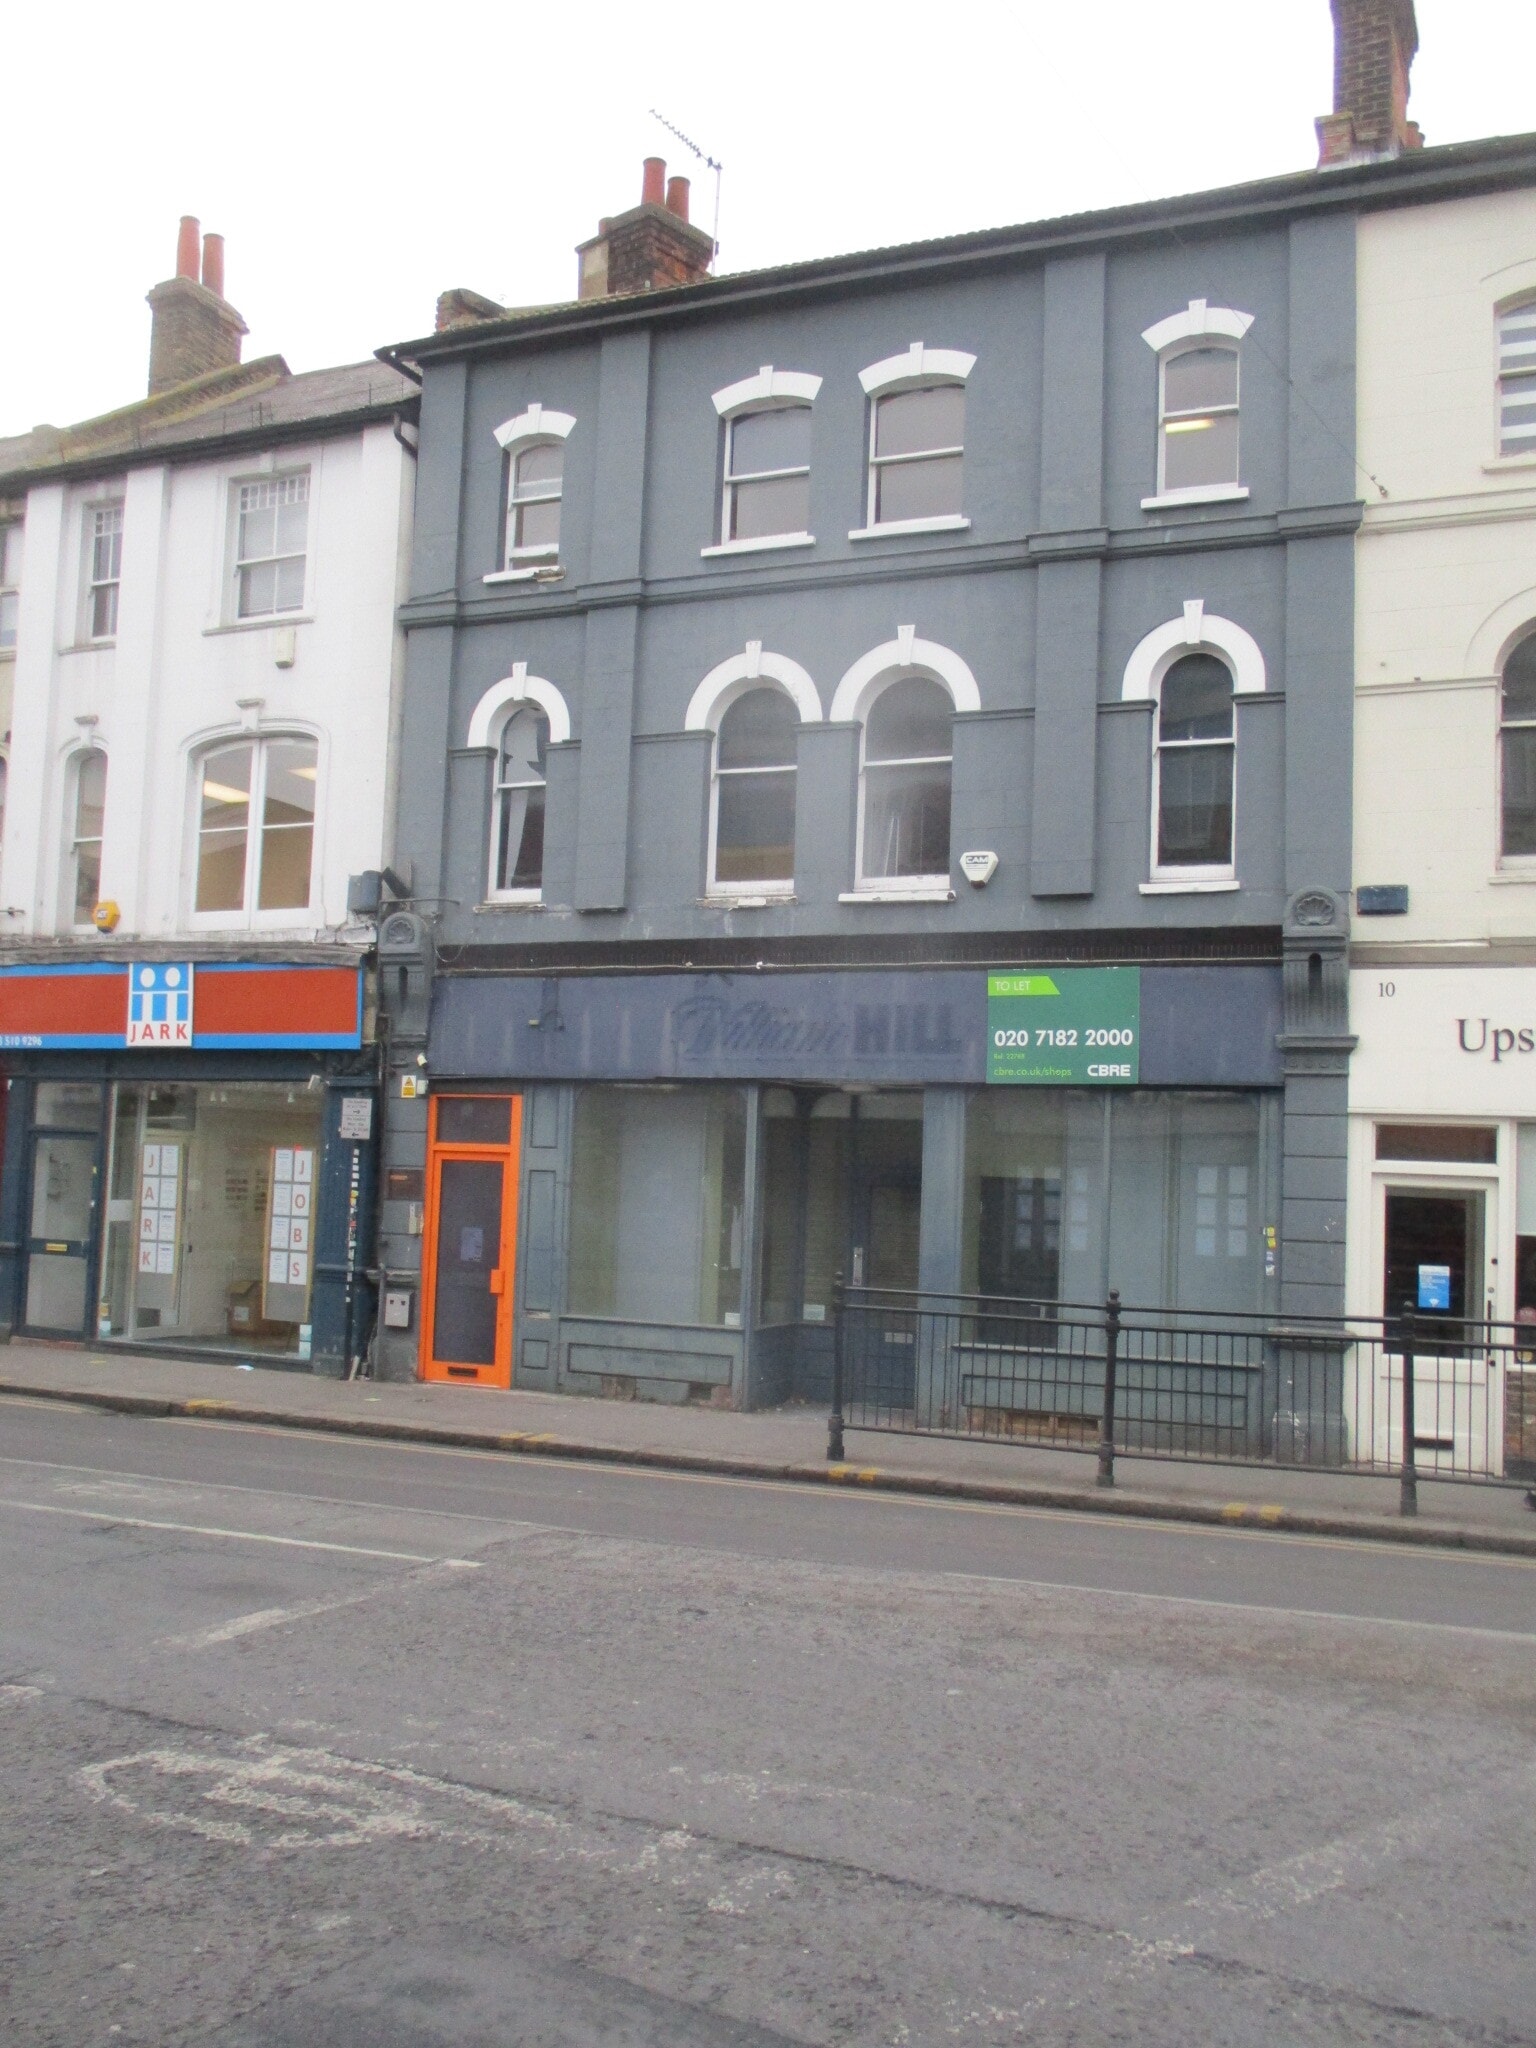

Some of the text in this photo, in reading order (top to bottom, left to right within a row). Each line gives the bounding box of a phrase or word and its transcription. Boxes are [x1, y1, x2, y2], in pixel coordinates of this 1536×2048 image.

[966, 856, 988, 864] CAM
[995, 980, 1031, 991] TO LET
[1378, 982, 1396, 997] 10
[130, 1023, 188, 1043] JARK
[994, 1029, 1134, 1046] 020 7182 2000
[993, 1067, 1073, 1077] cbre.co.uk/shops
[1087, 1064, 1131, 1077] CBRE
